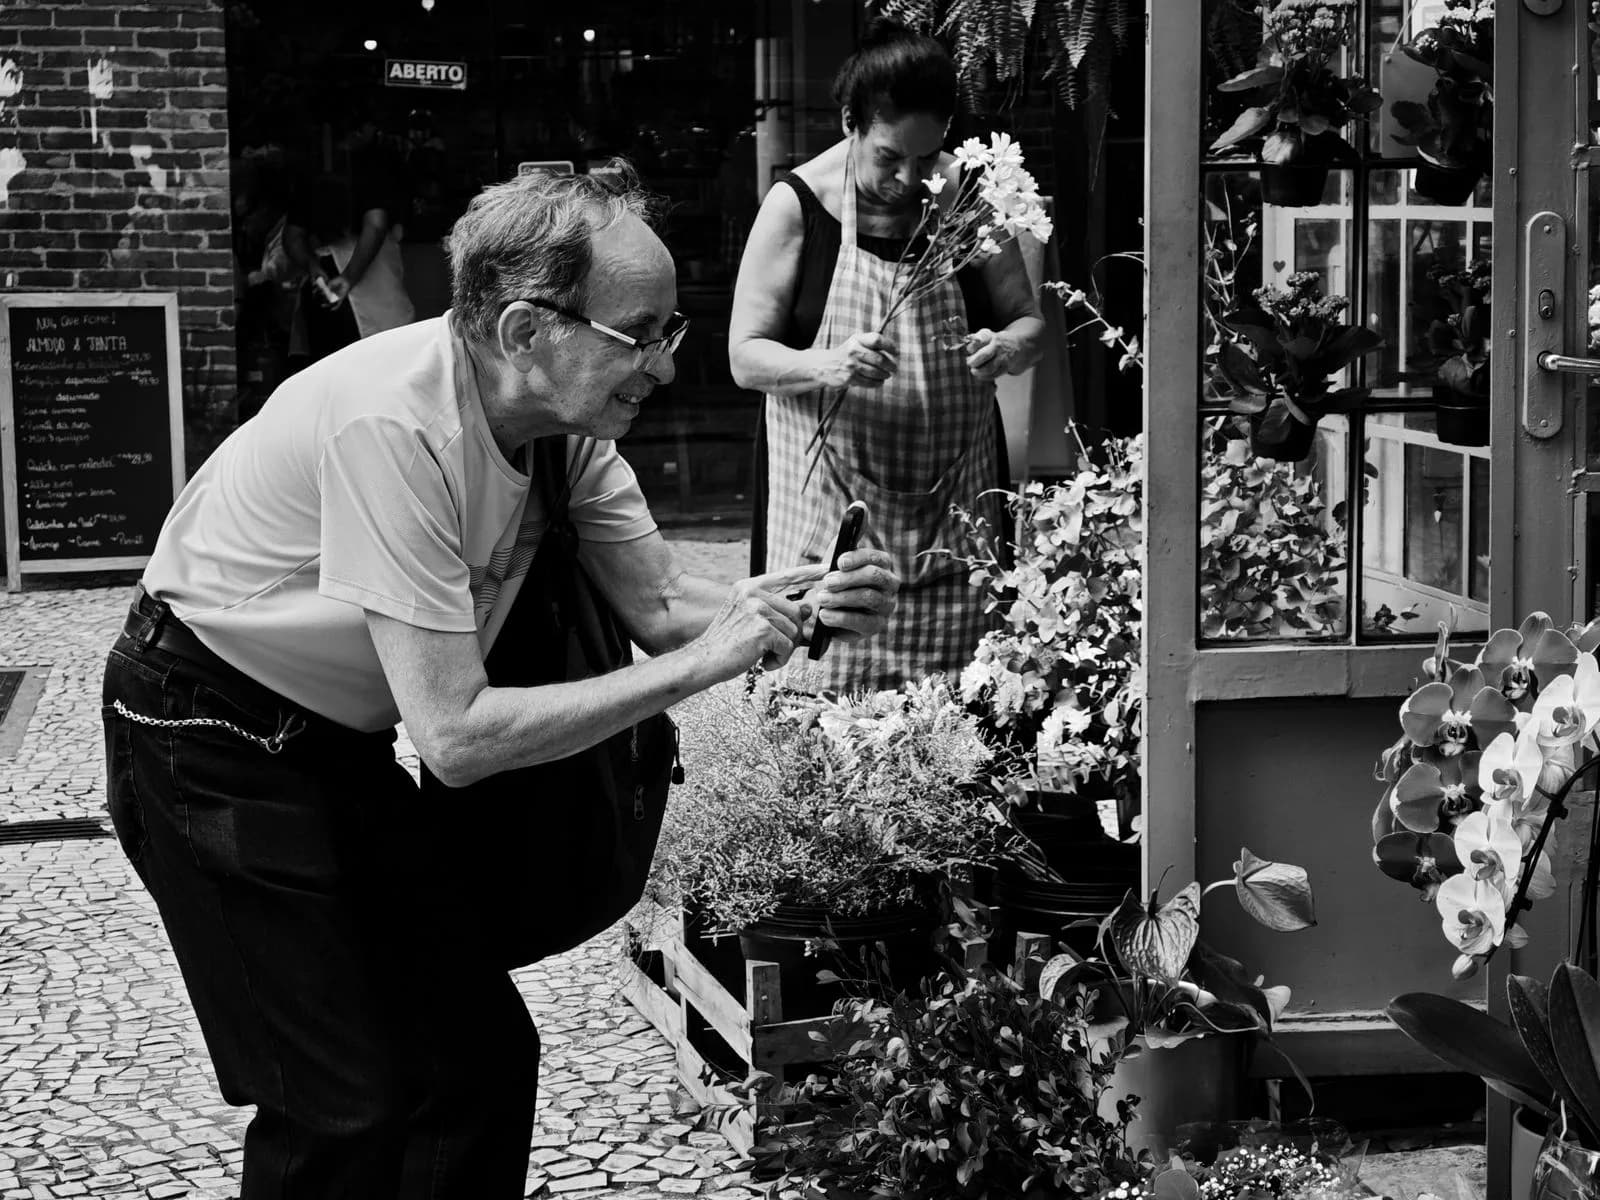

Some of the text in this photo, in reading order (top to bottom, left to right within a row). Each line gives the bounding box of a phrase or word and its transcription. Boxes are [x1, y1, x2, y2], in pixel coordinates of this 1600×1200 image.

[389, 63, 463, 81] ABERTO
[26, 336, 65, 354] ALMOÇO
[86, 336, 127, 351] JANTA
[27, 459, 58, 472] Quiche
